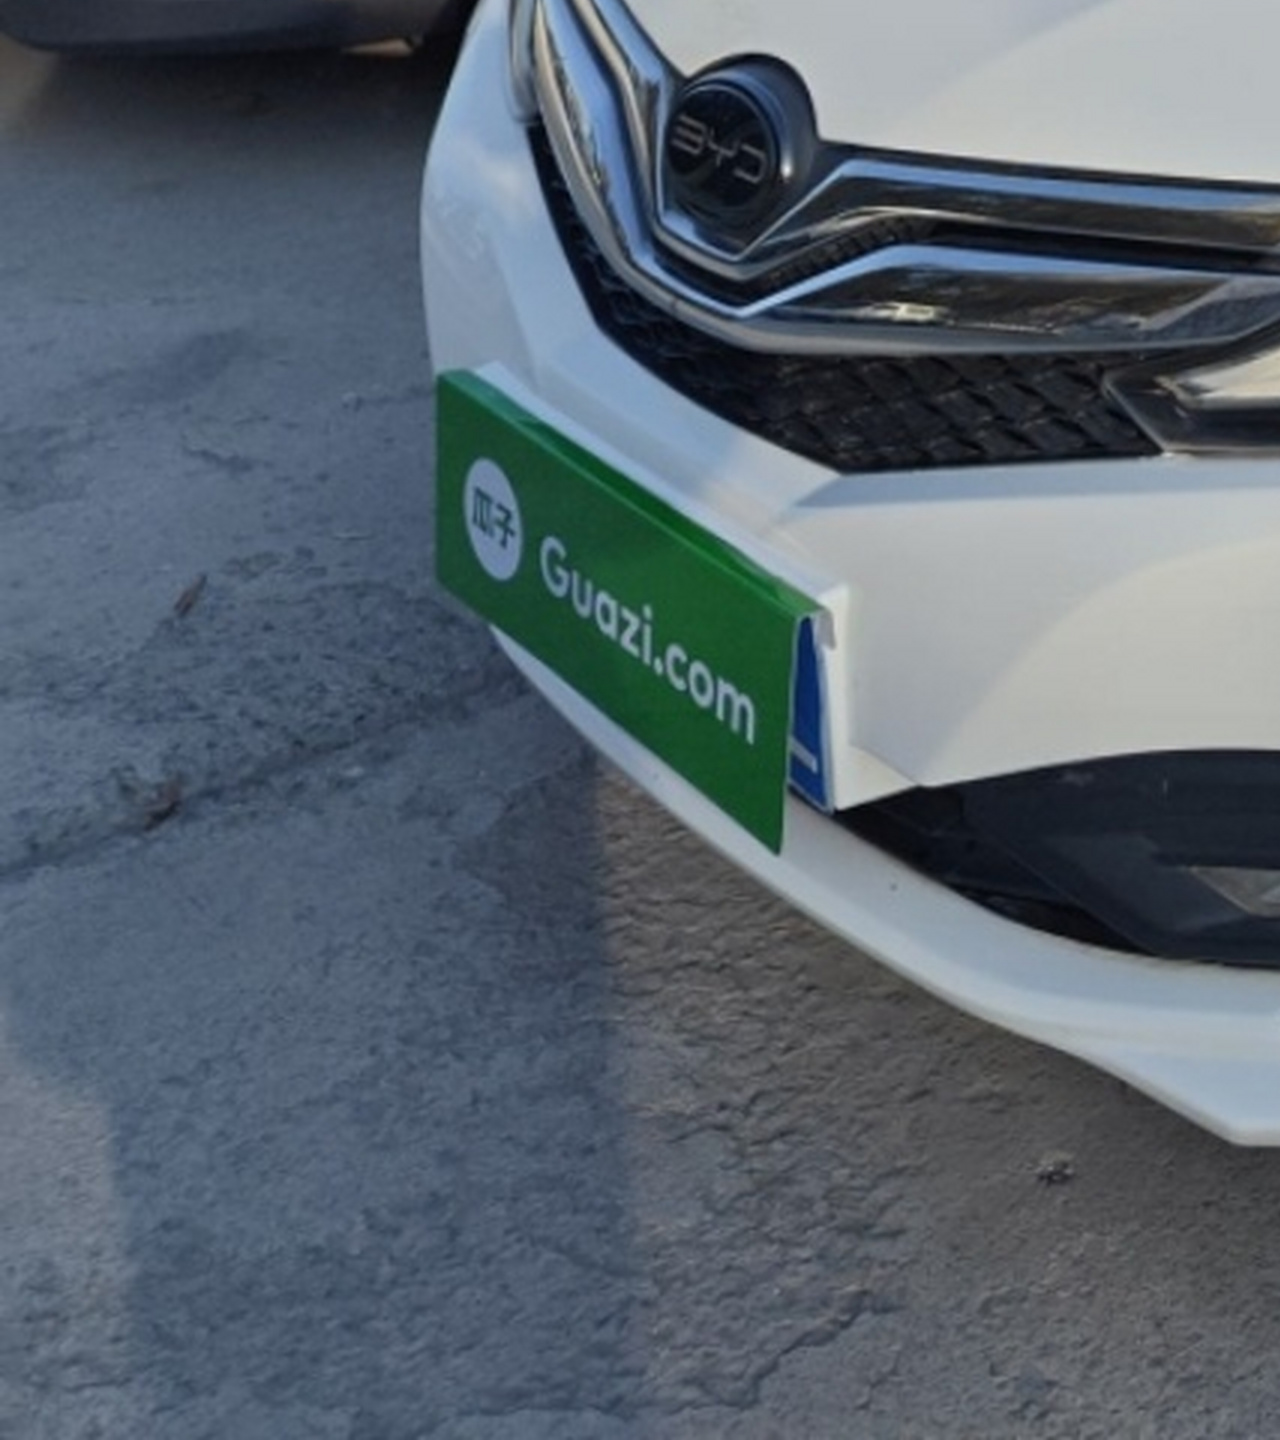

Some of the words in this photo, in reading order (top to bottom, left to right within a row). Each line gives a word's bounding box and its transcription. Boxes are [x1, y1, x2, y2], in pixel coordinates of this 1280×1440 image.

[671, 113, 766, 183] BYD
[473, 486, 515, 550] 瓜子
[540, 536, 756, 744] Guazi.com
